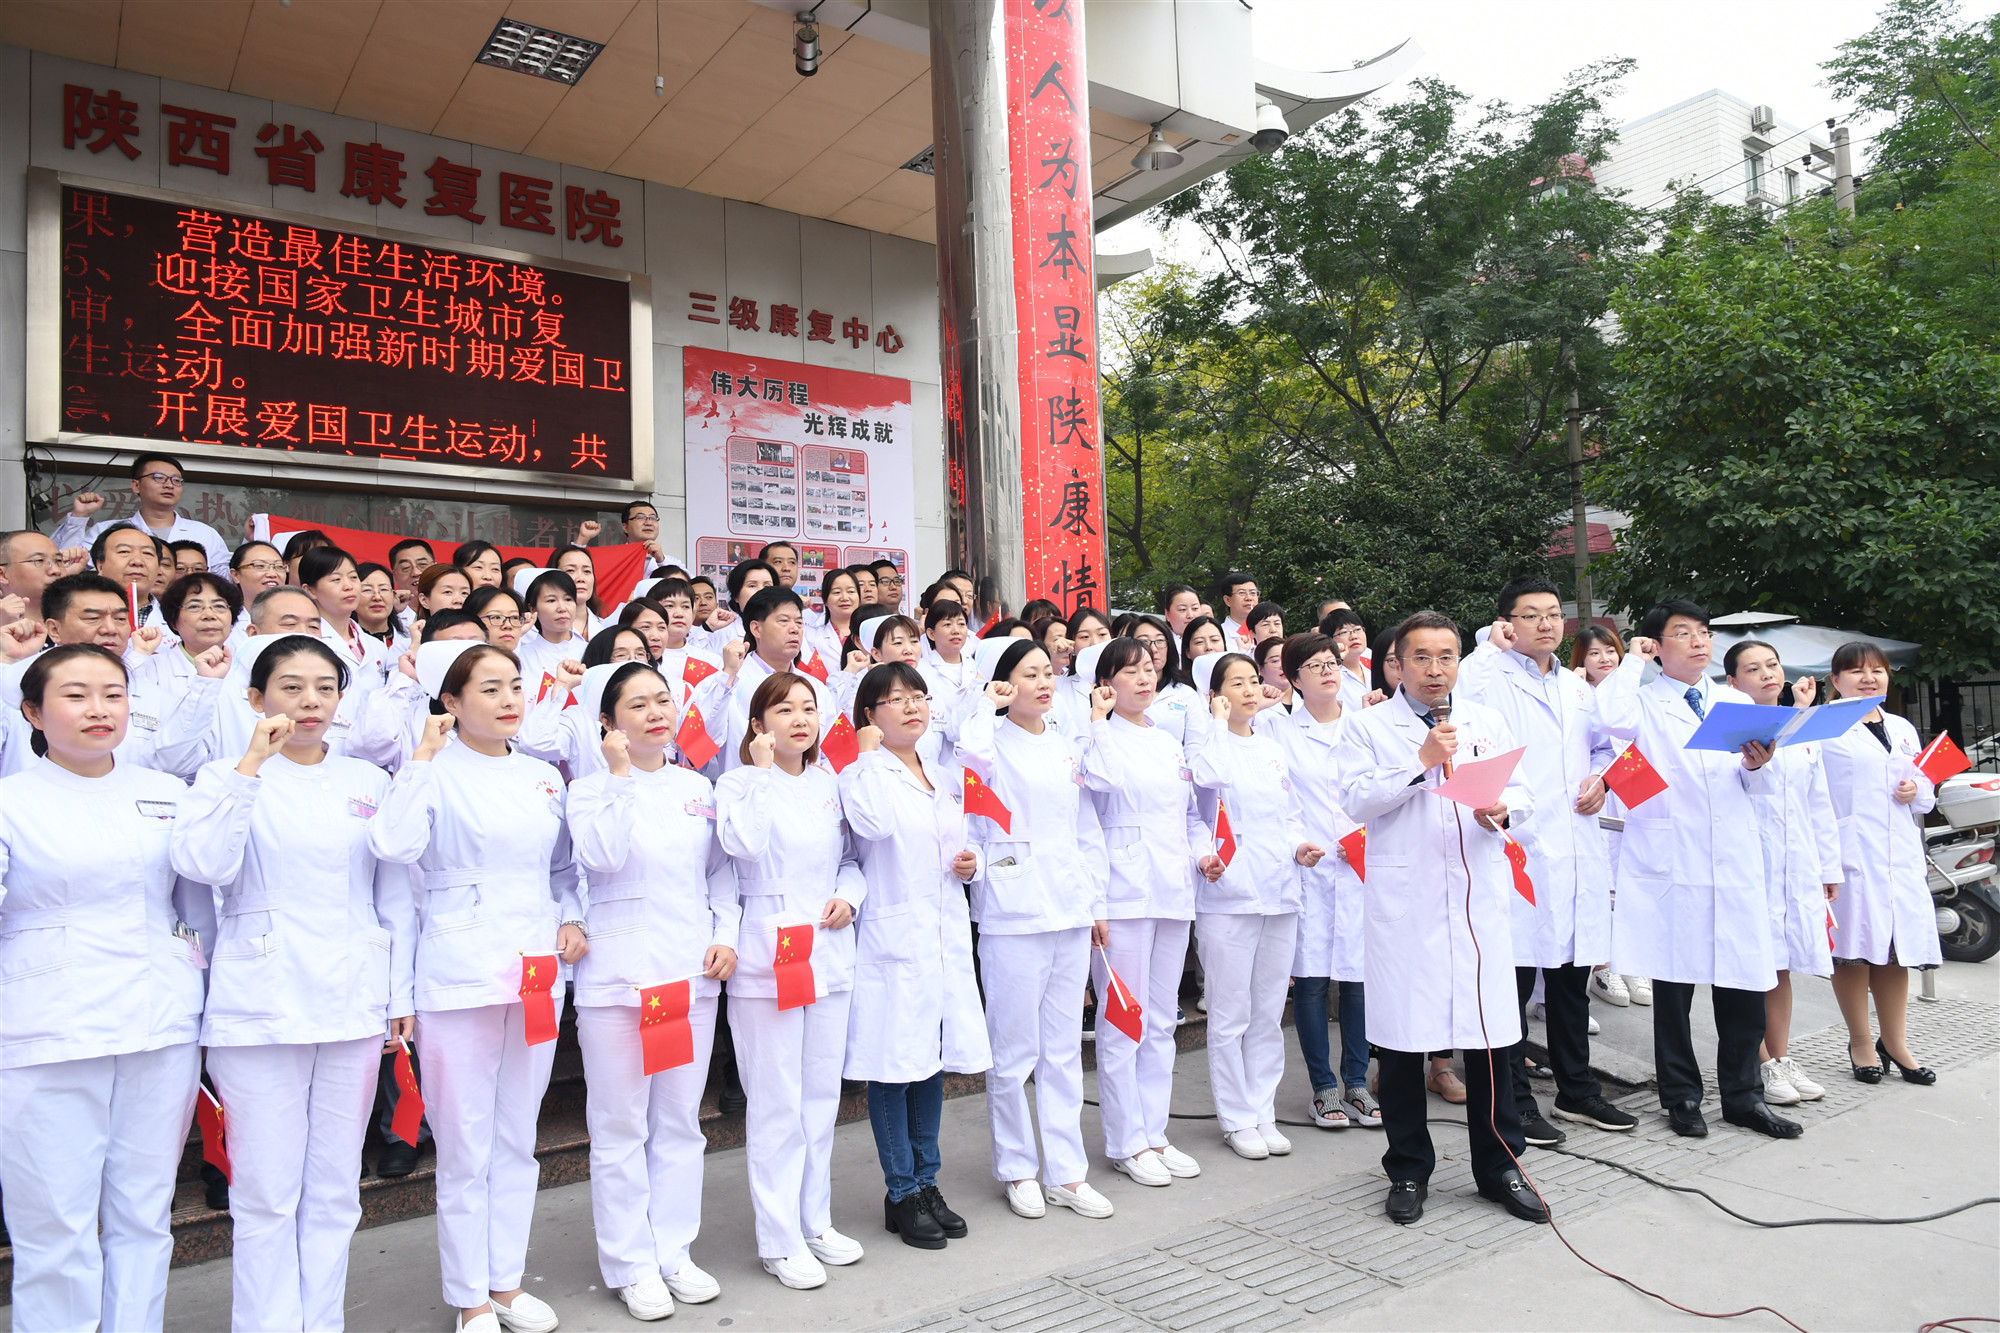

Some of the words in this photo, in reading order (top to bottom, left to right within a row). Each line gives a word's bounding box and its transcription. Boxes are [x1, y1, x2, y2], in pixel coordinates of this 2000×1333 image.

[62, 83, 624, 248] 陕西省康复医院
[688, 292, 904, 353] 三级康复中心
[710, 370, 810, 407] 伟大历程
[803, 412, 895, 444] 光辉成就
